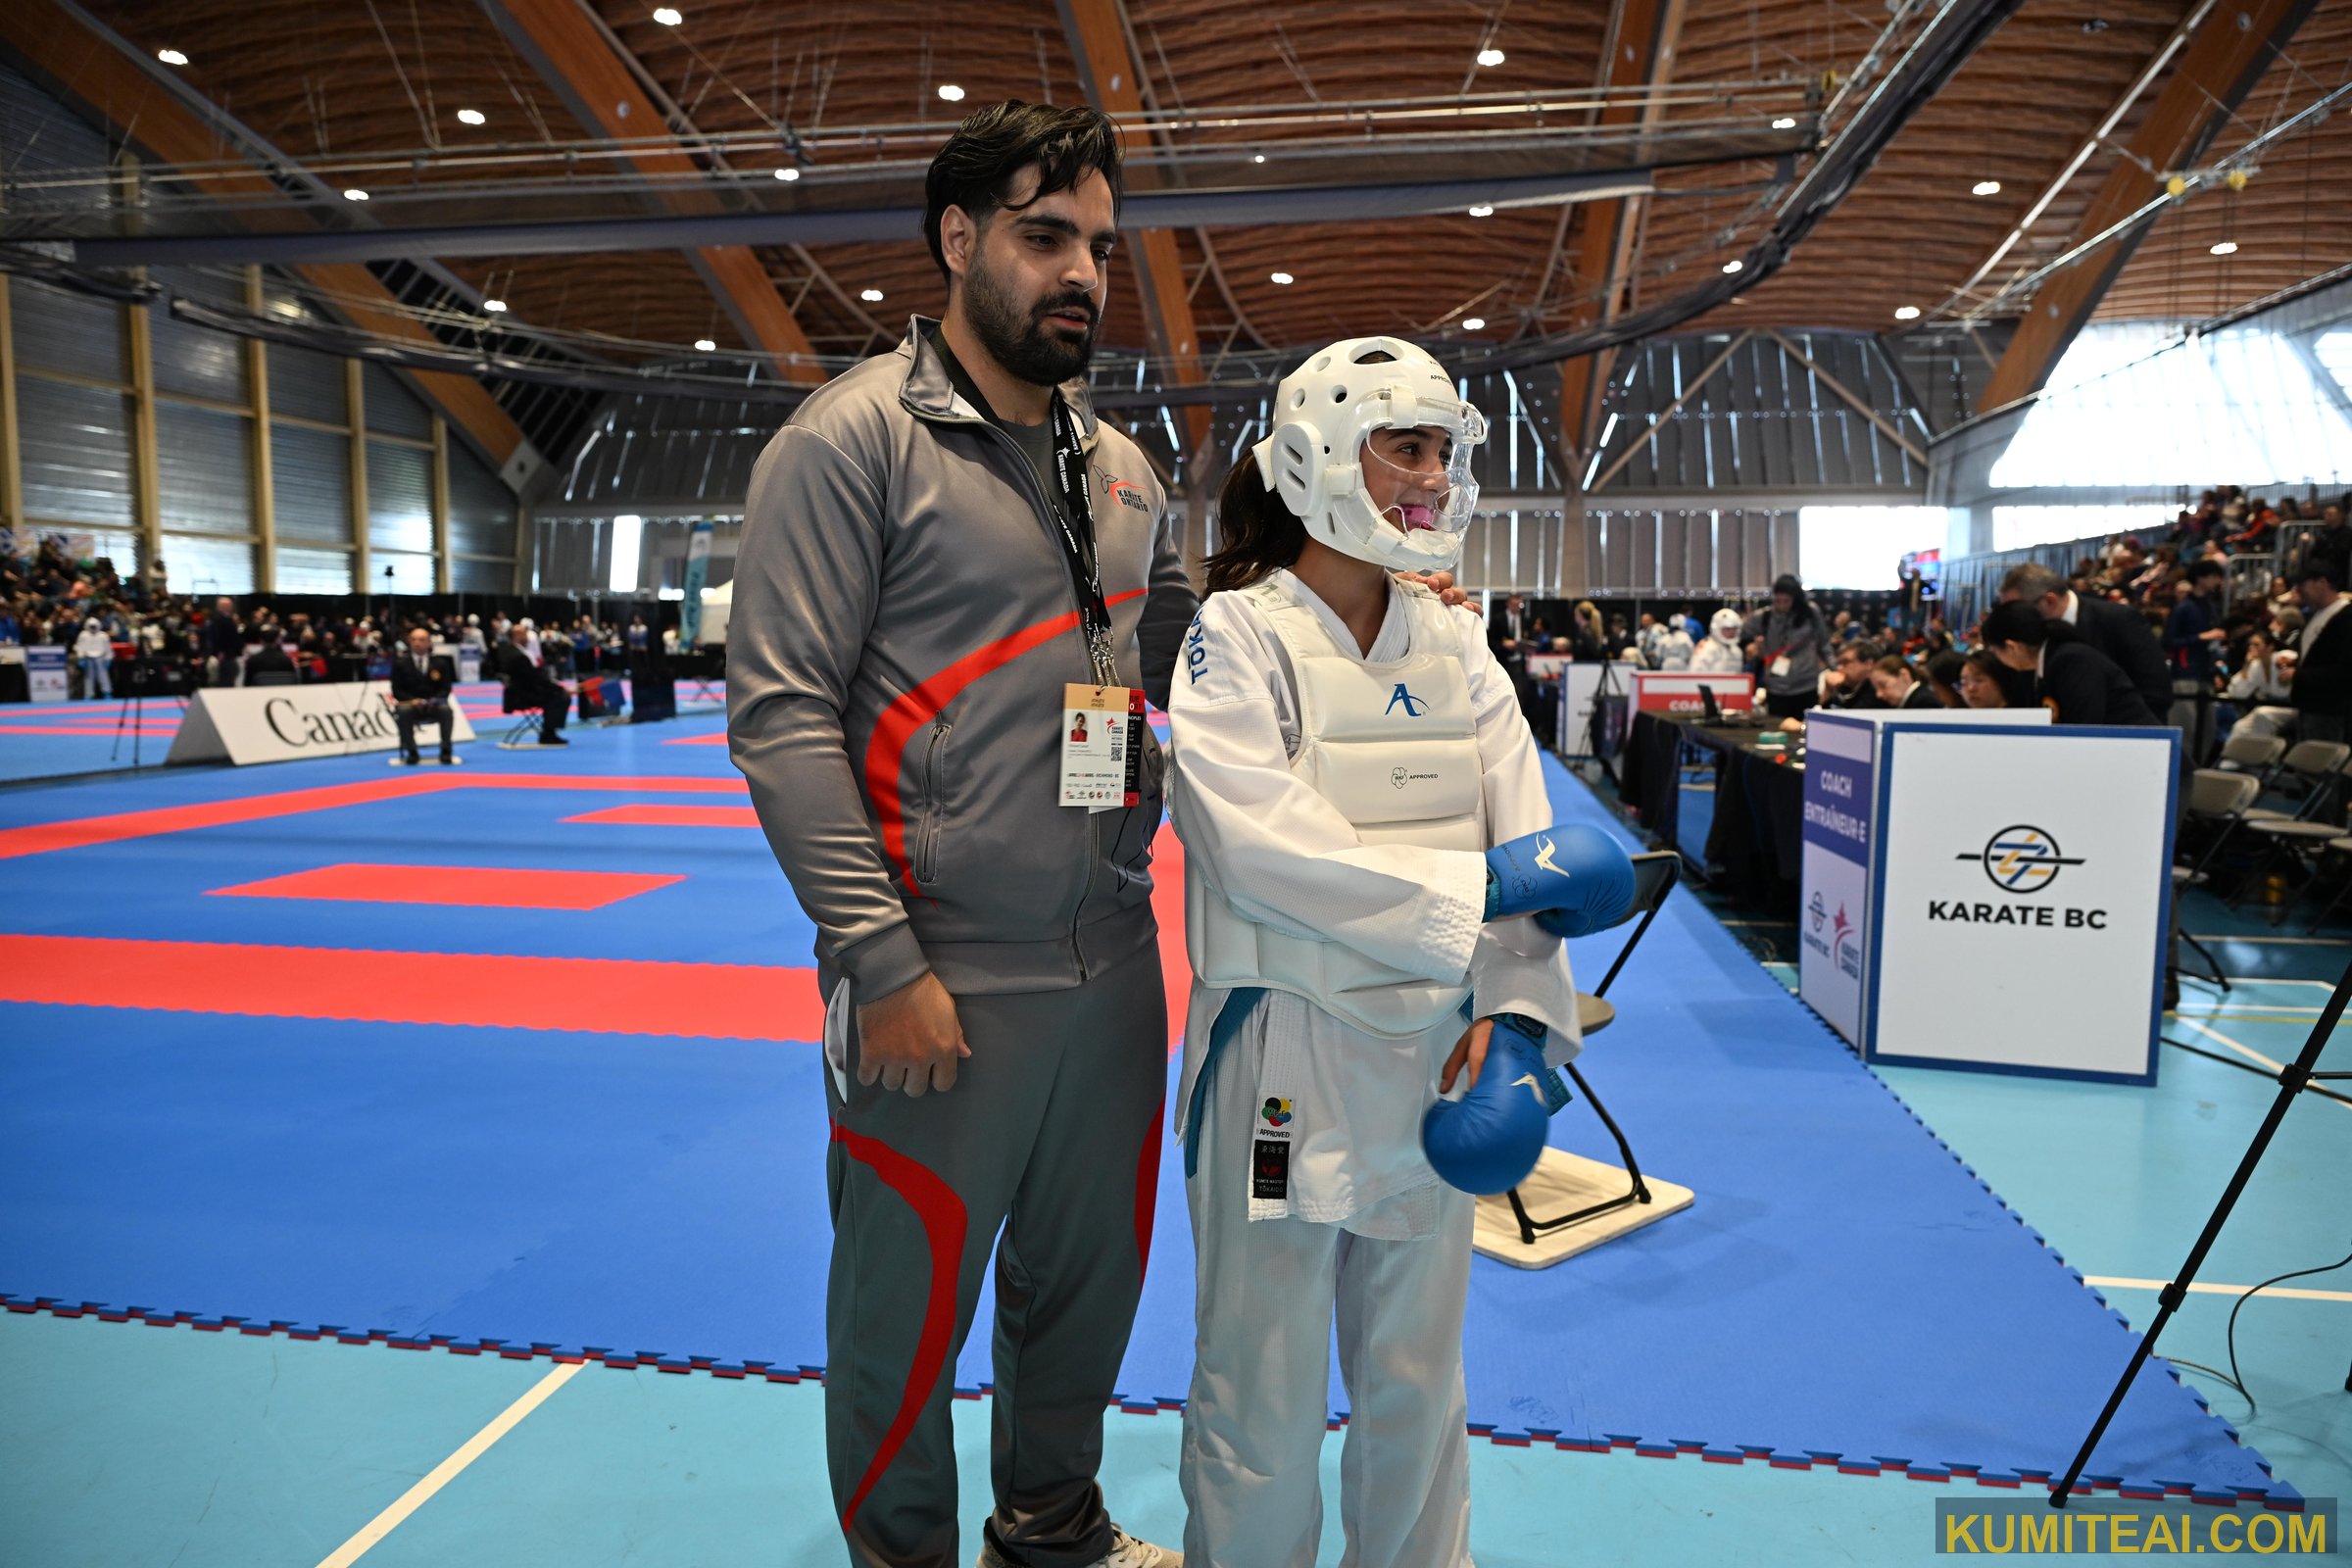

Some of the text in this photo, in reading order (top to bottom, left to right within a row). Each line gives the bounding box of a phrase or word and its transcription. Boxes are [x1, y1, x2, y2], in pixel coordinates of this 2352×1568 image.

[1059, 470, 1070, 494] CANADA
[1116, 489, 1144, 504] KARATE
[1120, 497, 1149, 513] ONTARIO
[264, 691, 426, 748] Canad
[1821, 770, 1853, 799] COACH
[1929, 900, 2108, 930] KARATE BC
[1259, 1128, 1291, 1138] APPROVED
